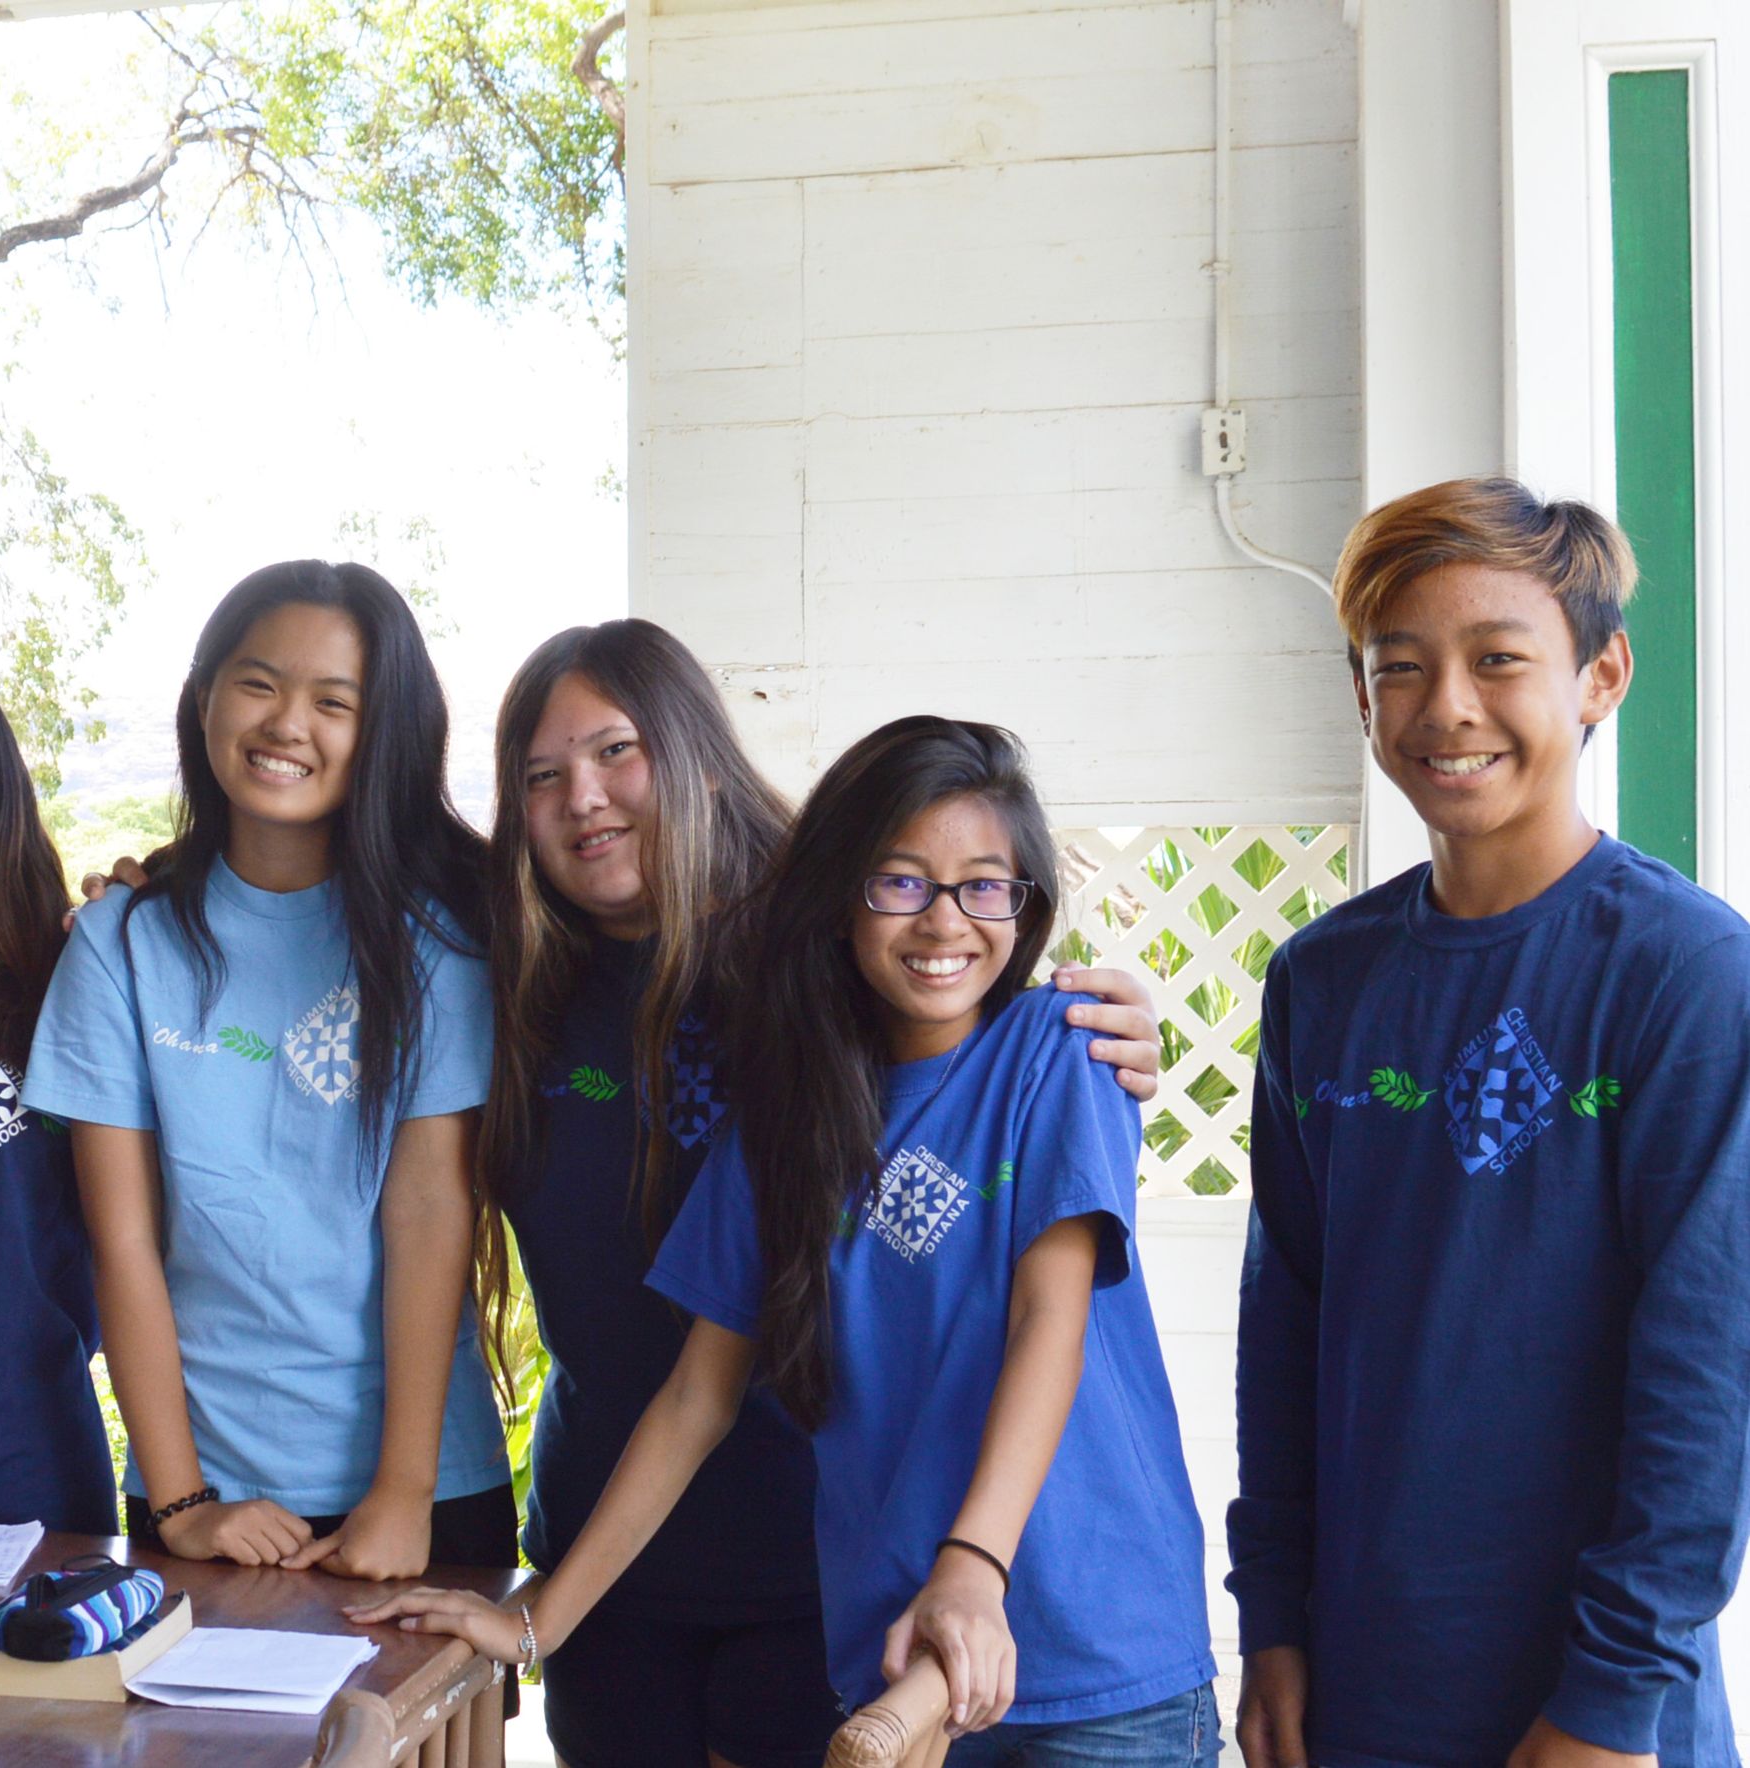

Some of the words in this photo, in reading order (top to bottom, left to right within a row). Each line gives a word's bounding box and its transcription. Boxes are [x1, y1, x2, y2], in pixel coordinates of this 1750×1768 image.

[284, 985, 341, 1041] KAIMUKI
[286, 1063, 312, 1097] HIGH
[1489, 1114, 1554, 1176] SCHOOL
[864, 1216, 915, 1265] SCHOOL
